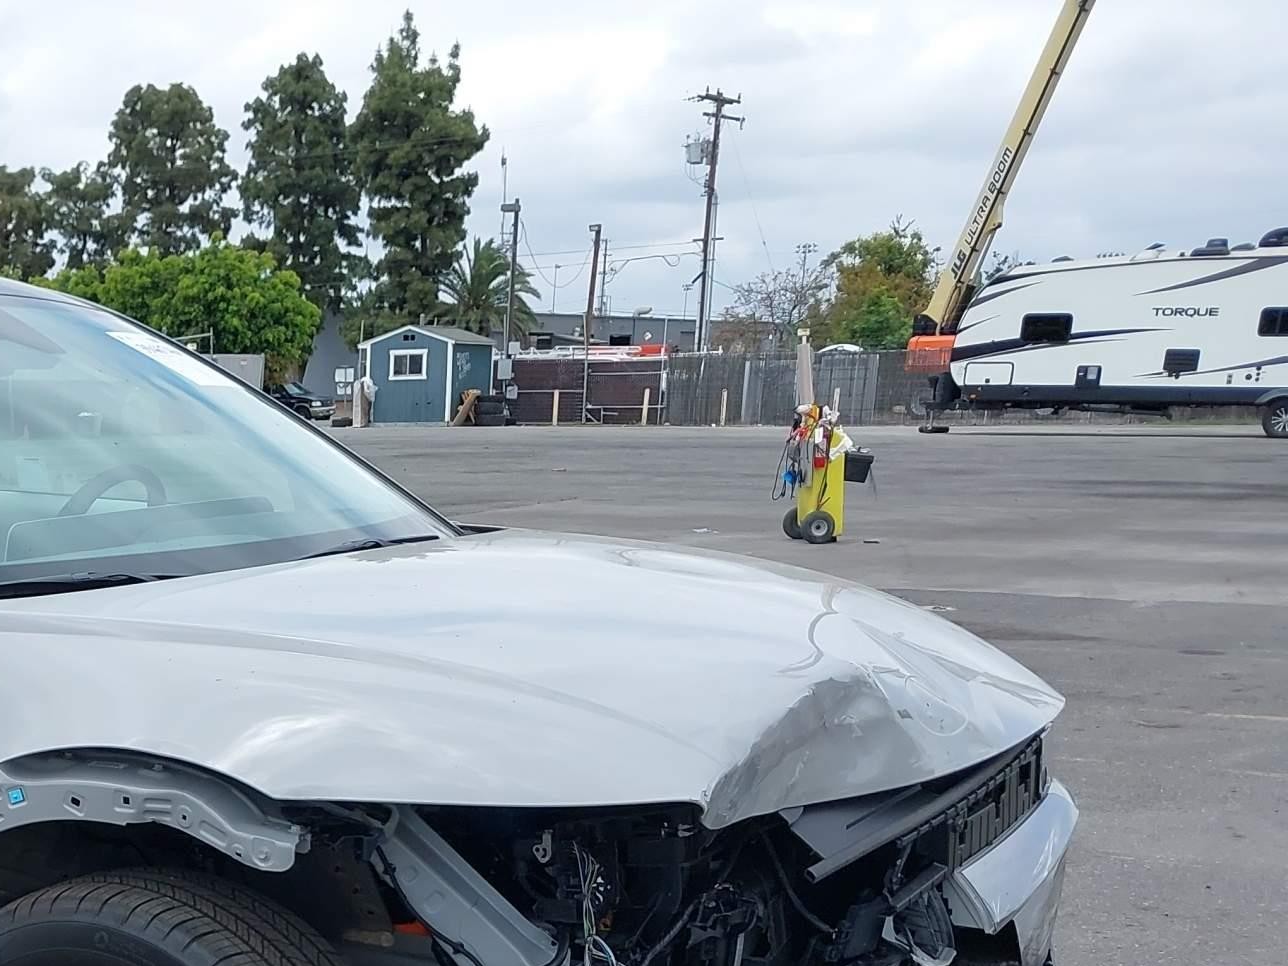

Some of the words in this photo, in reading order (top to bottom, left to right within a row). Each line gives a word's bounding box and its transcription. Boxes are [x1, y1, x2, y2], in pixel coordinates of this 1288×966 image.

[951, 249, 967, 280] JLG
[965, 195, 991, 246] ULTRA
[988, 147, 1013, 195] BOOM
[1152, 307, 1220, 318] TORQUE
